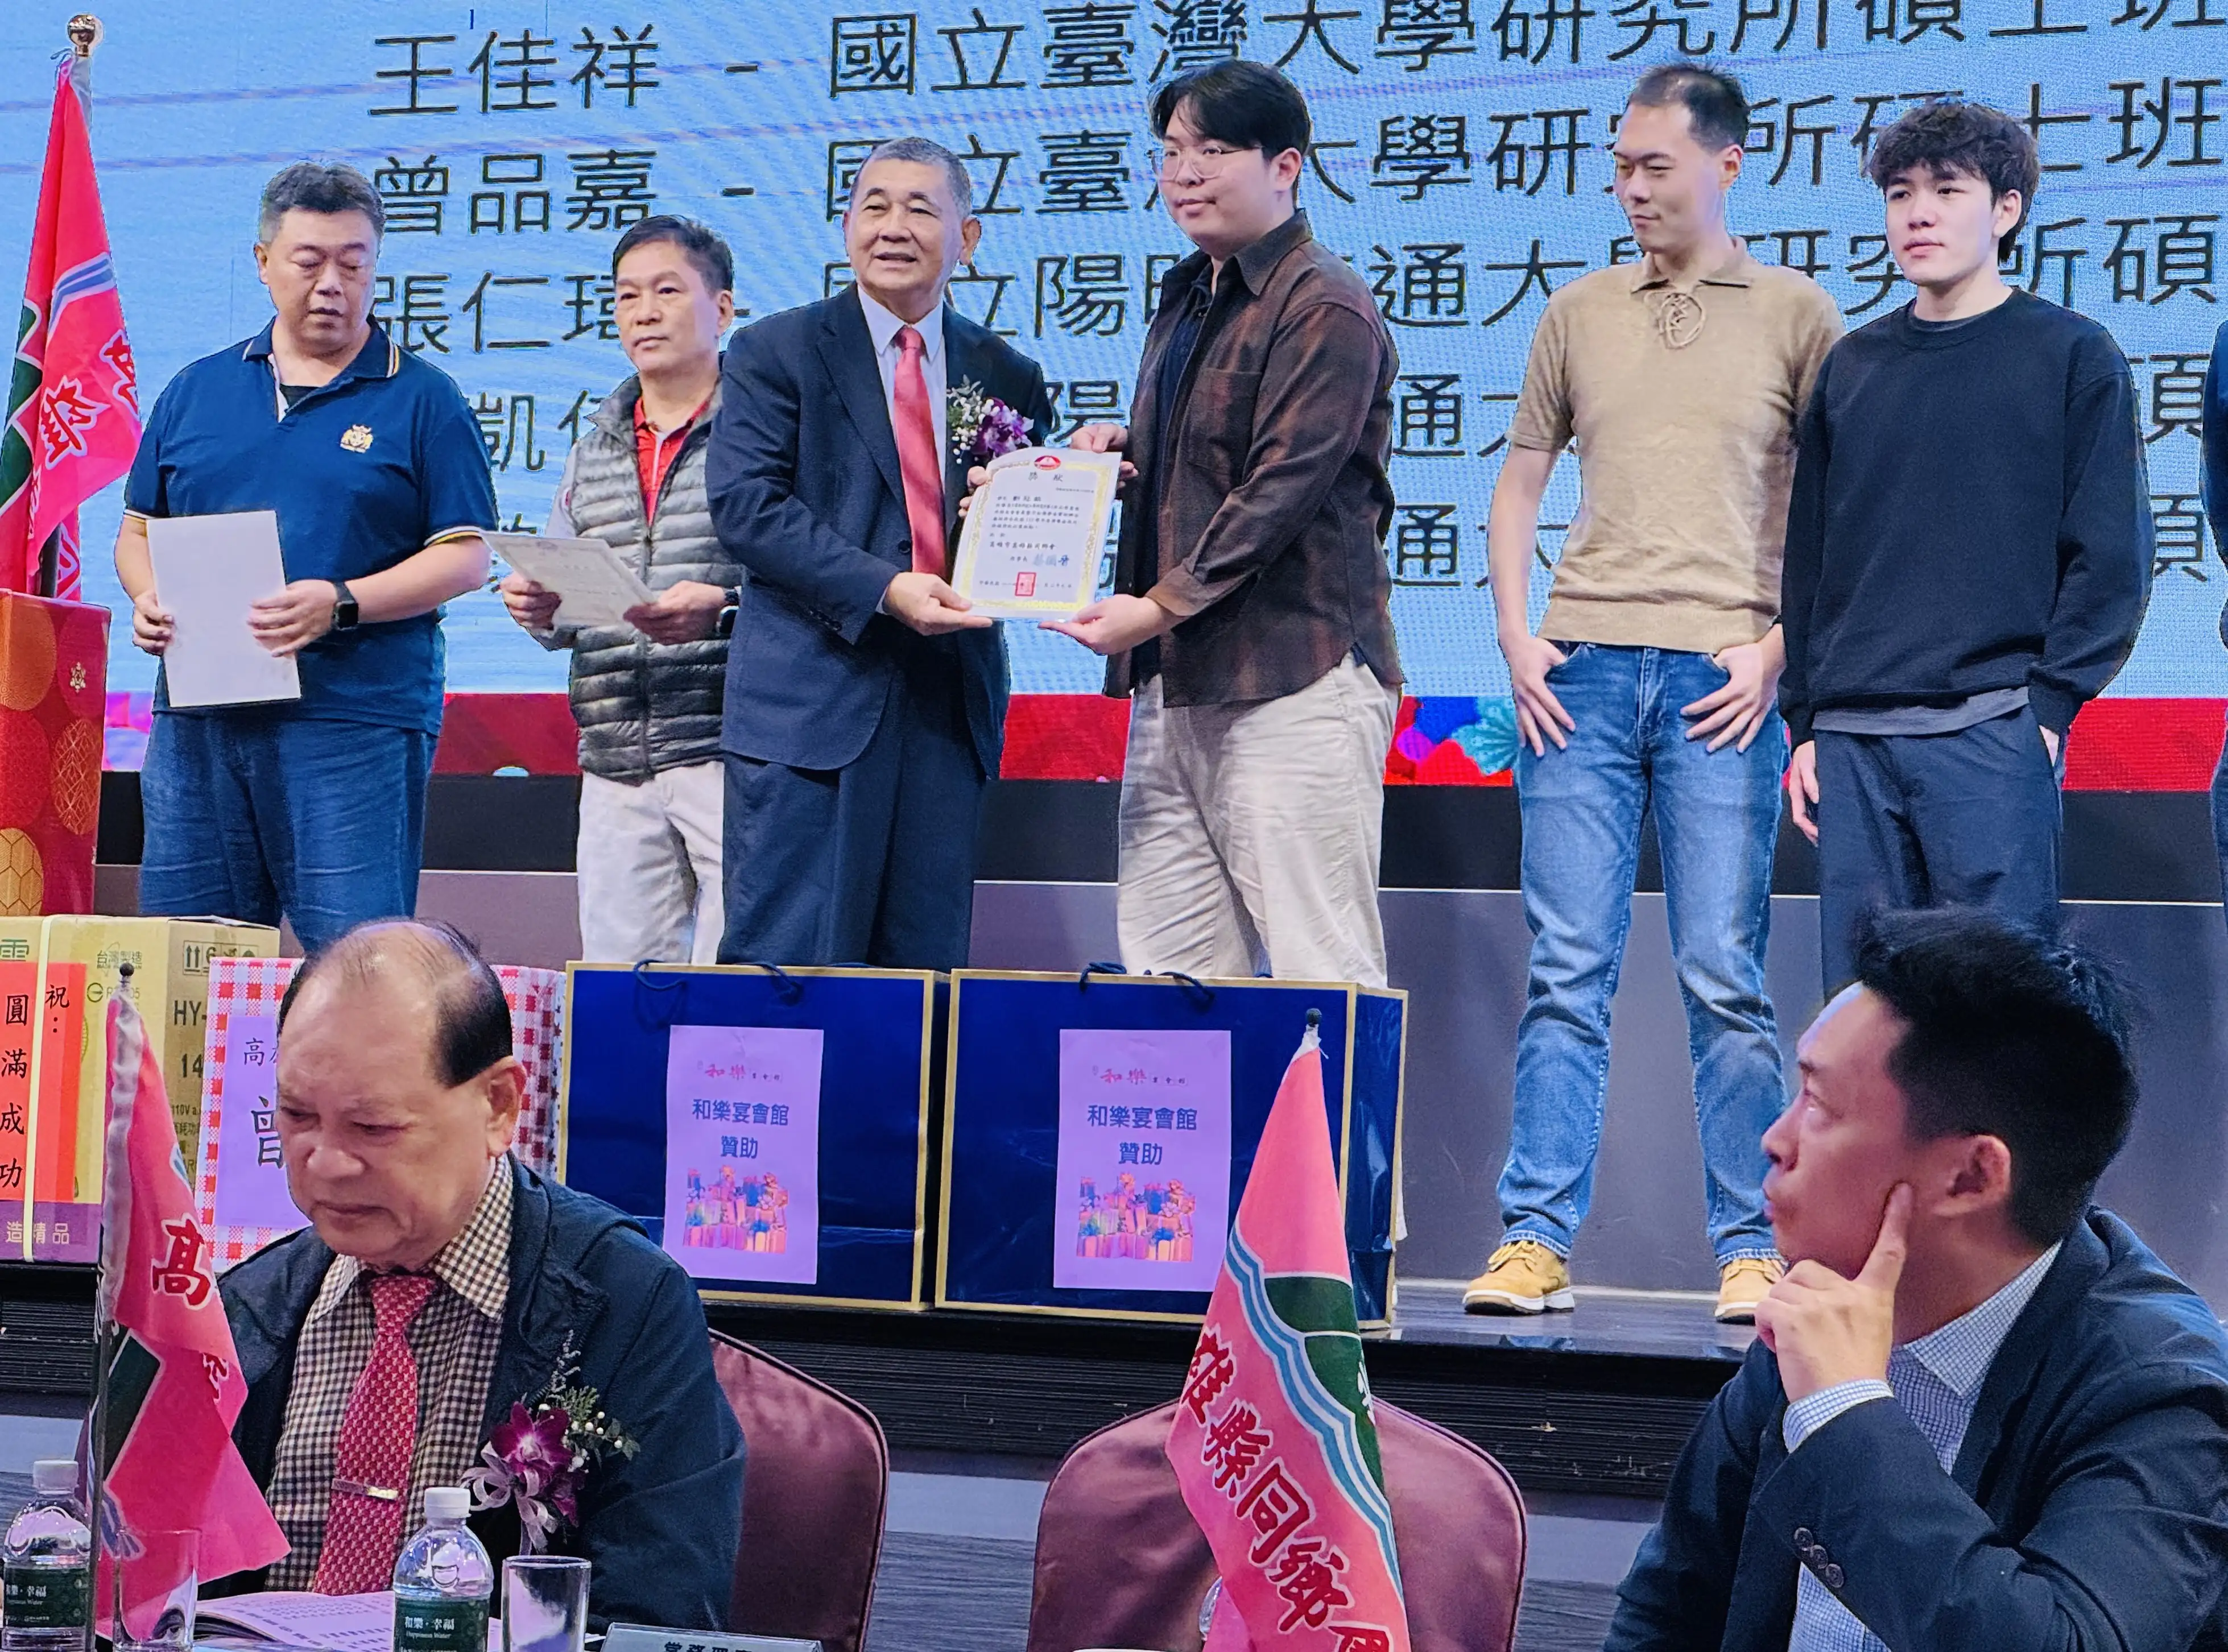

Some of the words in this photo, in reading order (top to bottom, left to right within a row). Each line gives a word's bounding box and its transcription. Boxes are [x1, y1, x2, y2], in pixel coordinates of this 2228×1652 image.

[369, 24, 660, 117] 王佳祥
[375, 150, 657, 234] 曾品嘉
[692, 1098, 789, 1127] 和樂宴會館
[1087, 1104, 1197, 1131] 和樂宴會館
